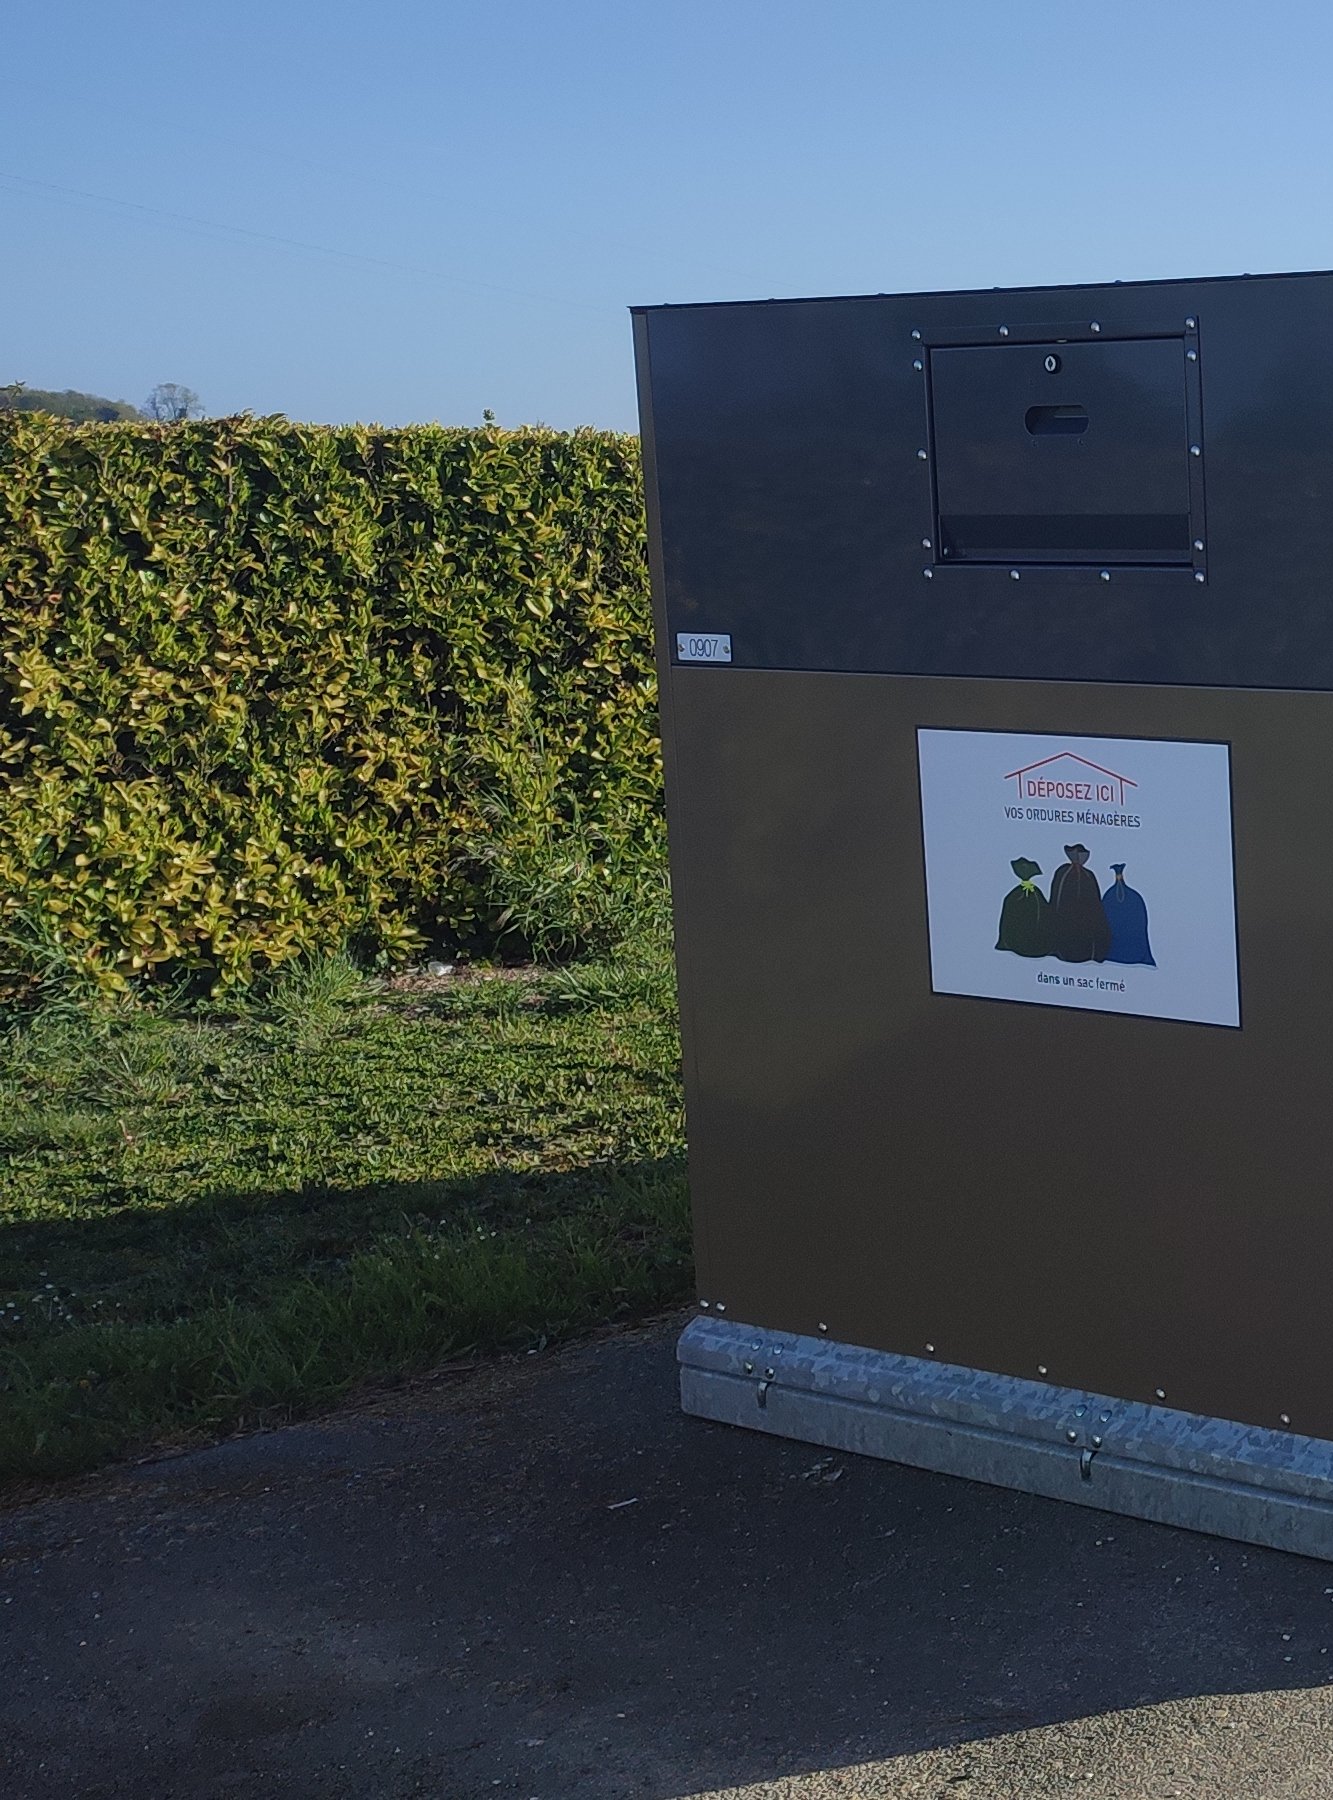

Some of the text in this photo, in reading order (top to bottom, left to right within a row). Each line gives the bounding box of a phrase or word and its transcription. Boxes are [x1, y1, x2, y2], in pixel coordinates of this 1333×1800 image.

[689, 638, 719, 658] 0907
[1027, 776, 1114, 802] DÉPOSEZ ICI
[1004, 806, 1141, 828] VOS ORDURES MÉNAGÈRES
[1037, 971, 1126, 993] dans un sac fermé
